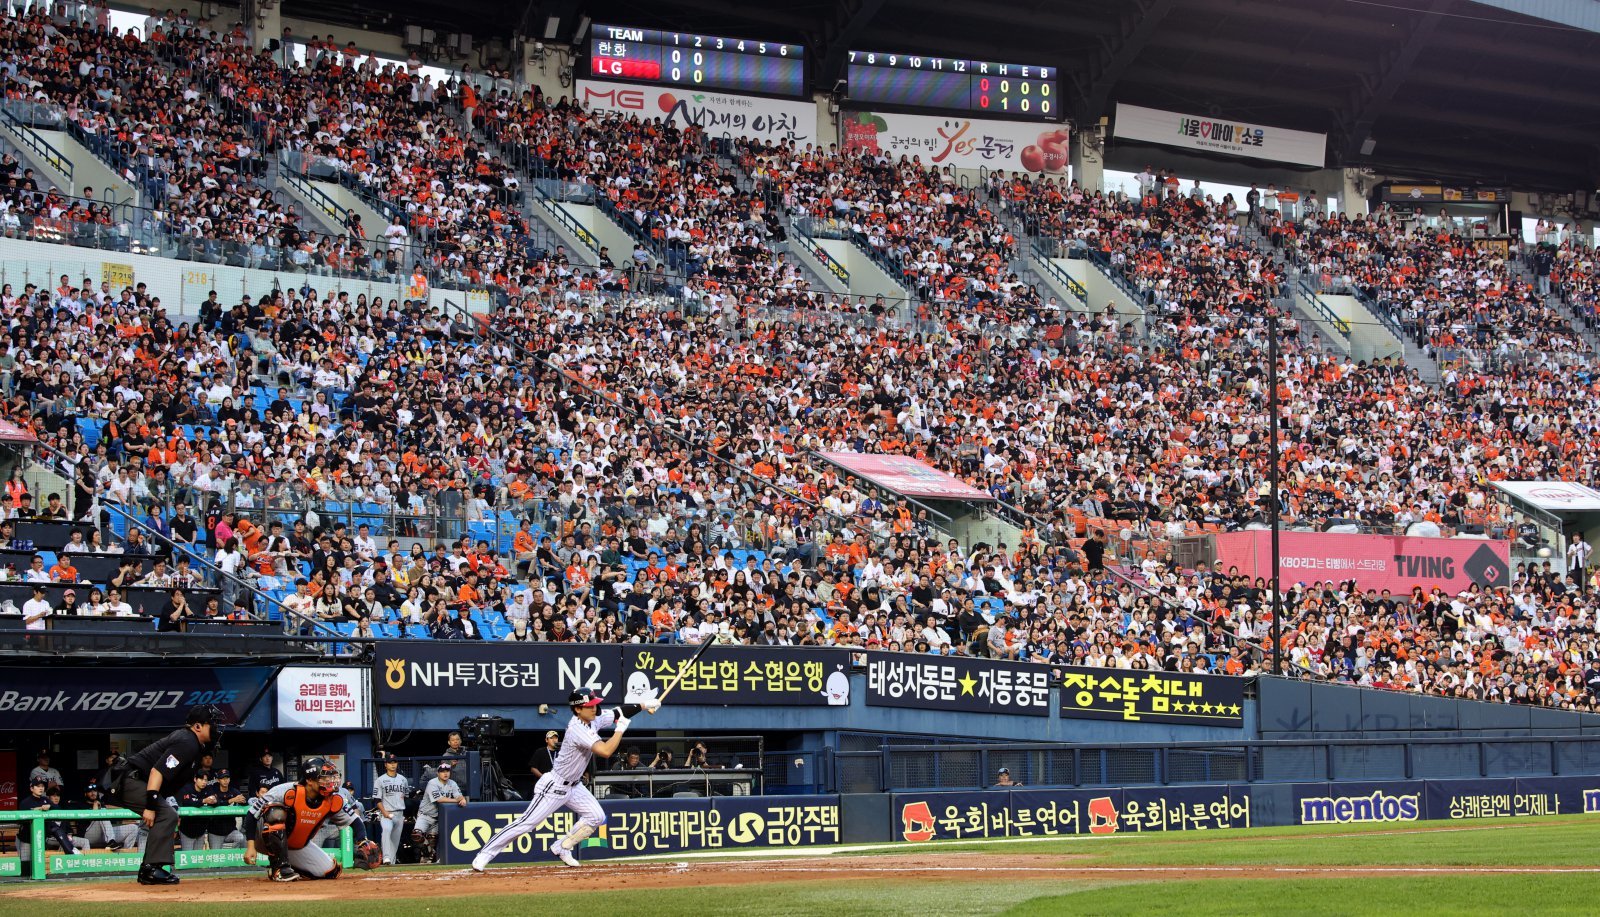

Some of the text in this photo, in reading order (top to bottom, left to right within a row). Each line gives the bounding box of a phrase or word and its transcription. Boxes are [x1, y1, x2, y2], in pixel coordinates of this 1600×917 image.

[598, 42, 702, 66] 한화 0 0
[608, 28, 787, 56] TEAM 1 2 3 4 5 6
[672, 68, 680, 80] 0
[694, 70, 702, 82] 0
[848, 52, 1048, 78] 7 8 9 10 11 12 R H E B
[585, 86, 644, 110] MG
[980, 78, 1050, 96] 0 0 0 0
[710, 96, 727, 105] 자연과
[980, 95, 1050, 113] 0 1 0 0
[752, 112, 808, 140] 아침
[890, 136, 937, 152] 긍정의 힘!
[932, 121, 977, 162] Yes
[976, 135, 1014, 160] 문경
[1042, 152, 1064, 160] 문경사과
[1326, 558, 1356, 570] 티빙에서
[1357, 559, 1386, 571] 스트리밍
[1394, 555, 1454, 580] TVING
[635, 651, 655, 670] Sh
[411, 662, 540, 688] NH투자증권
[743, 660, 824, 692] 수협은행
[868, 660, 1049, 707] 태성자동문 자동중문
[184, 690, 240, 706] 2025
[300, 684, 327, 697] 승리를
[1063, 672, 1203, 721] 장수돌침대
[294, 699, 356, 712] 하나의 트윈스!
[938, 800, 1080, 838] 육회바른연어
[1120, 796, 1250, 832] 육회바른연어
[1301, 790, 1419, 824] mentos
[1450, 795, 1510, 820] 상쾌함엔
[1514, 793, 1560, 816] 언제나
[608, 809, 724, 850] 금강펜테리움
[767, 806, 839, 846] 금강주택
[127, 857, 143, 866] 트래
